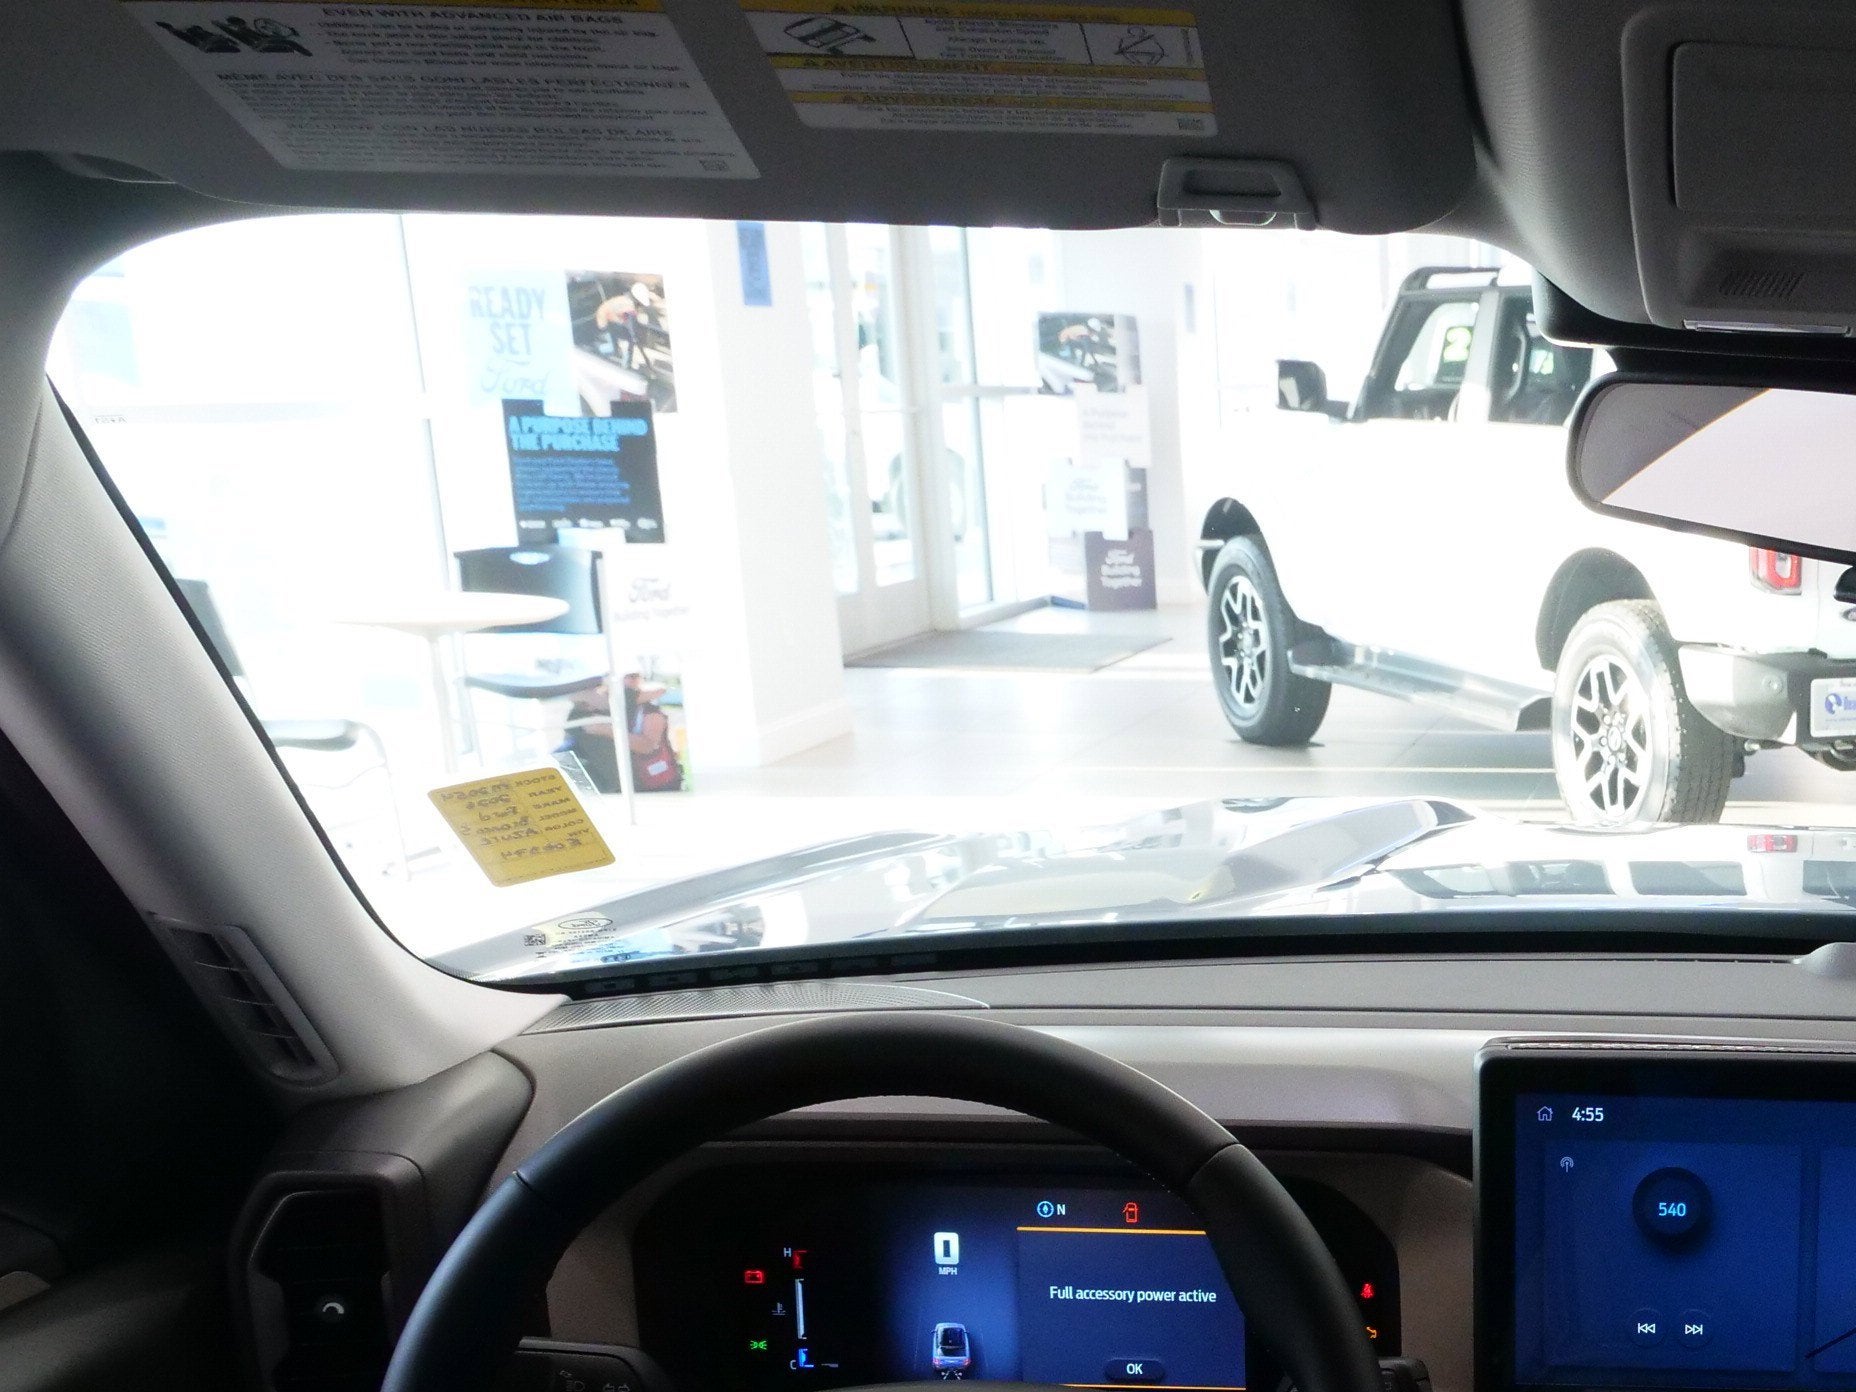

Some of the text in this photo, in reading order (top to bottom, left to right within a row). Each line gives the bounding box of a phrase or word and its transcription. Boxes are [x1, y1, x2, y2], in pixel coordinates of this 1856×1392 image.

[468, 285, 545, 321] READY
[489, 322, 532, 356] SET
[1571, 1107, 1604, 1122] 4:55
[1057, 1204, 1066, 1216] N
[1658, 1202, 1687, 1217] 540
[783, 1247, 792, 1258] H
[938, 1267, 958, 1276] MPH
[1049, 1285, 1217, 1304] Full accessory power active
[1126, 1363, 1144, 1375] OK
